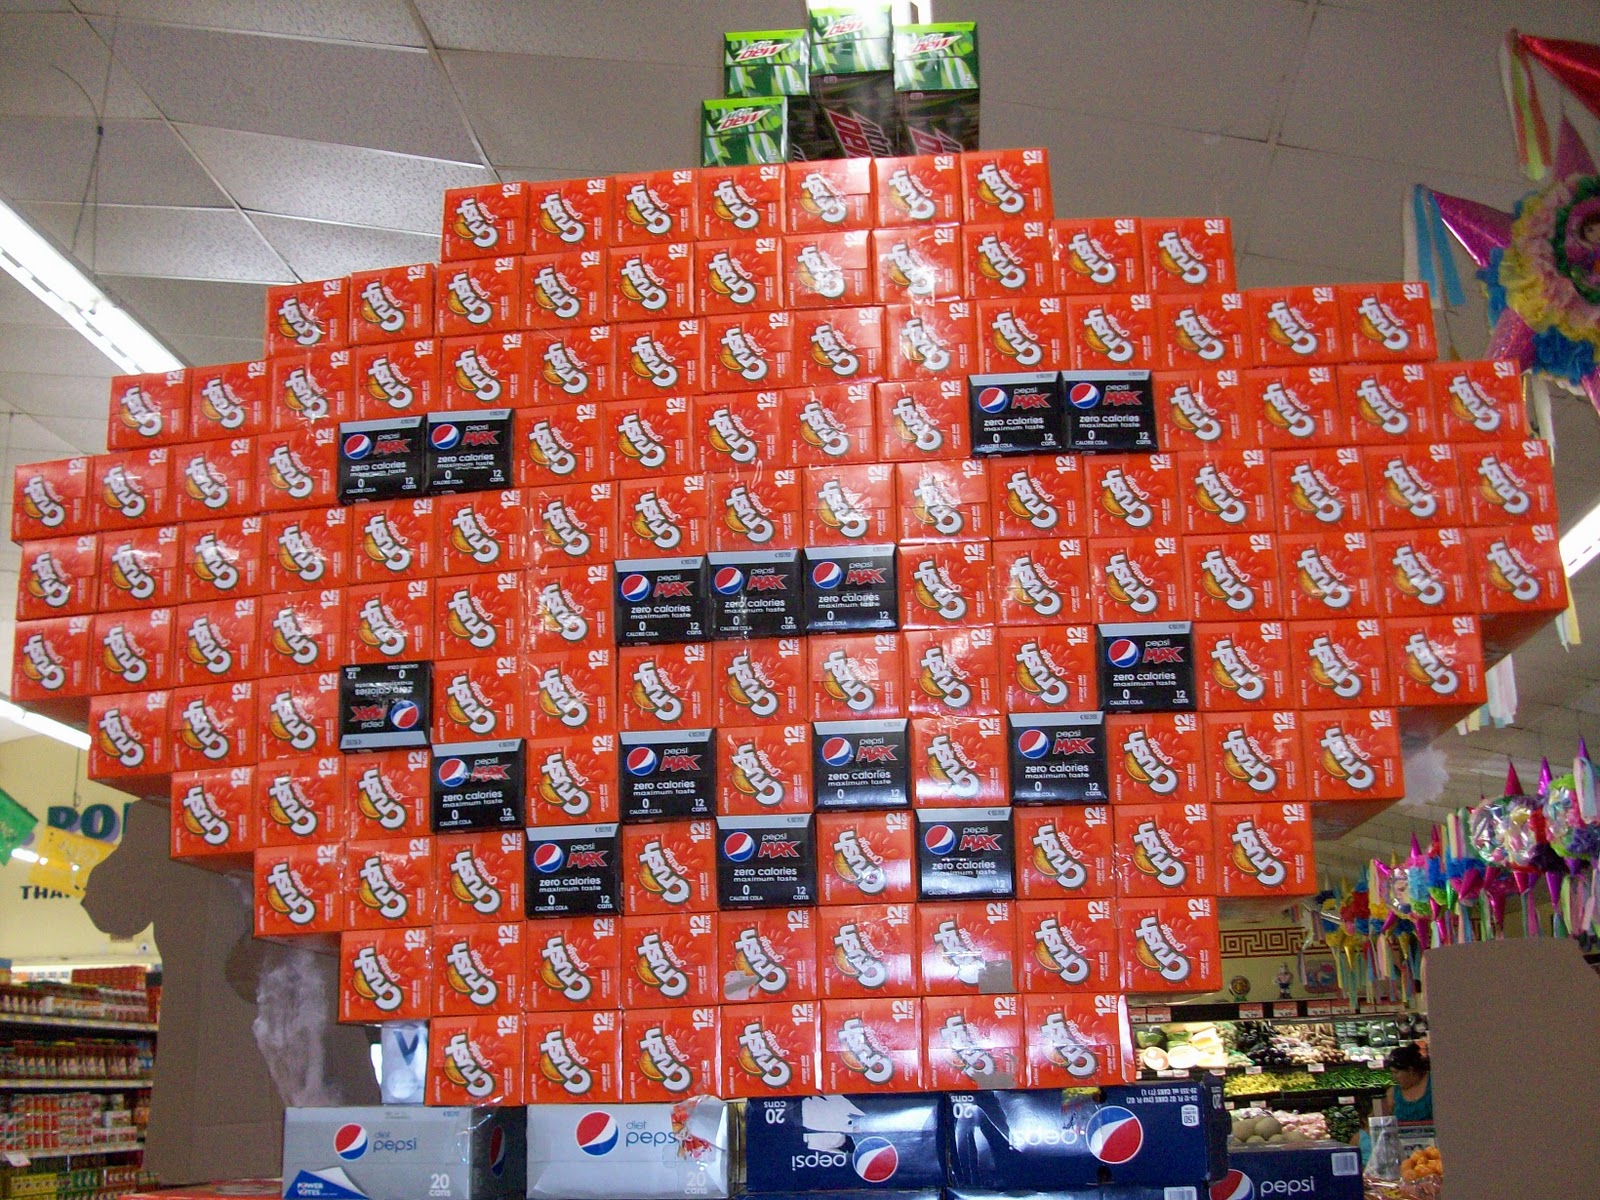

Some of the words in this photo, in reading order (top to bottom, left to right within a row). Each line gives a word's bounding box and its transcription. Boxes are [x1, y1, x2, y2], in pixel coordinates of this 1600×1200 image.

[672, 170, 683, 186] 12
[503, 182, 513, 198] 12
[979, 163, 1022, 214] Crush
[627, 183, 670, 234] Crush
[456, 196, 499, 247] Crush
[1159, 230, 1206, 286] Crush
[622, 257, 667, 310] Crush
[280, 297, 321, 345] Crush
[1359, 296, 1406, 352] Crush
[1085, 307, 1132, 363] Crush
[722, 327, 767, 380] Crush
[457, 350, 500, 401] Crush
[1010, 393, 1051, 409] MAX
[1450, 374, 1498, 432] Crush
[121, 387, 162, 436] Crush
[984, 419, 1005, 427] zero
[1006, 416, 1044, 425] calories
[461, 430, 500, 446] MAX
[709, 407, 756, 463] Crush
[231, 441, 244, 457] 12
[437, 456, 457, 464] zero
[458, 453, 494, 462] calories
[69, 458, 82, 476] 12
[270, 446, 313, 497] Crush
[24, 477, 65, 526] Crush
[1102, 468, 1152, 528] Crush
[452, 507, 499, 563] Crush
[193, 534, 240, 590] Crush
[656, 574, 681, 582] pepsi
[1297, 548, 1349, 610] Crush
[652, 580, 694, 597] MAX
[448, 590, 496, 648] Crush
[630, 605, 652, 614] zero
[653, 604, 691, 613] calories
[1145, 639, 1170, 648] pepsi
[22, 635, 67, 688] Crush
[1142, 646, 1185, 664] MAX
[1405, 632, 1459, 696] Crush
[727, 655, 779, 717] Crush
[1113, 673, 1135, 681] zero
[1136, 671, 1176, 681] calories
[1122, 689, 1130, 699] 0
[1176, 690, 1186, 698] 12
[1055, 730, 1081, 738] pepsi
[1176, 714, 1190, 734] 12
[99, 710, 146, 766] Crush
[1053, 737, 1096, 755] MAX
[474, 756, 499, 765] pepsi
[663, 747, 688, 756] pepsi
[470, 764, 512, 781] MAX
[659, 754, 702, 772] MAX
[1025, 765, 1047, 773] zero
[1049, 761, 1089, 772] calories
[1123, 731, 1177, 795] Crush
[633, 781, 655, 790] zero
[656, 779, 696, 789] calories
[731, 743, 785, 807] Crush
[442, 794, 463, 802] zero
[464, 790, 503, 800] calories
[642, 798, 650, 808] 0
[694, 799, 704, 807] 12
[1284, 804, 1299, 824] 12
[762, 833, 787, 841] pepsi
[758, 840, 801, 858] MAX
[1231, 821, 1286, 887] Crush
[638, 841, 692, 905] Crush
[733, 867, 756, 876] zero
[757, 866, 797, 875] calories
[267, 864, 317, 924] Crush
[742, 884, 750, 895] 0
[796, 886, 806, 894] 12
[1088, 901, 1104, 922] 12
[1188, 899, 1204, 920] 12
[498, 925, 512, 946] 12
[593, 918, 608, 940] 12
[690, 915, 705, 937] 12
[1034, 918, 1089, 984] Crush
[1135, 916, 1190, 982] Crush
[446, 943, 498, 1005] Crush
[540, 937, 594, 1001] Crush
[636, 934, 690, 998] Crush
[1095, 995, 1111, 1016] 12
[639, 1028, 693, 1092] Crush
[763, 1100, 787, 1108] cans
[950, 1094, 974, 1102] cans
[626, 1120, 647, 1130] diet
[765, 1108, 786, 1124] 20
[373, 1137, 417, 1152] pepsi
[791, 1151, 847, 1172] pepsi
[430, 1173, 449, 1189] 20
[687, 1172, 706, 1187] 20
[1260, 1176, 1315, 1195] pepsi
[428, 1188, 451, 1197] cans
[684, 1186, 708, 1195] cans
